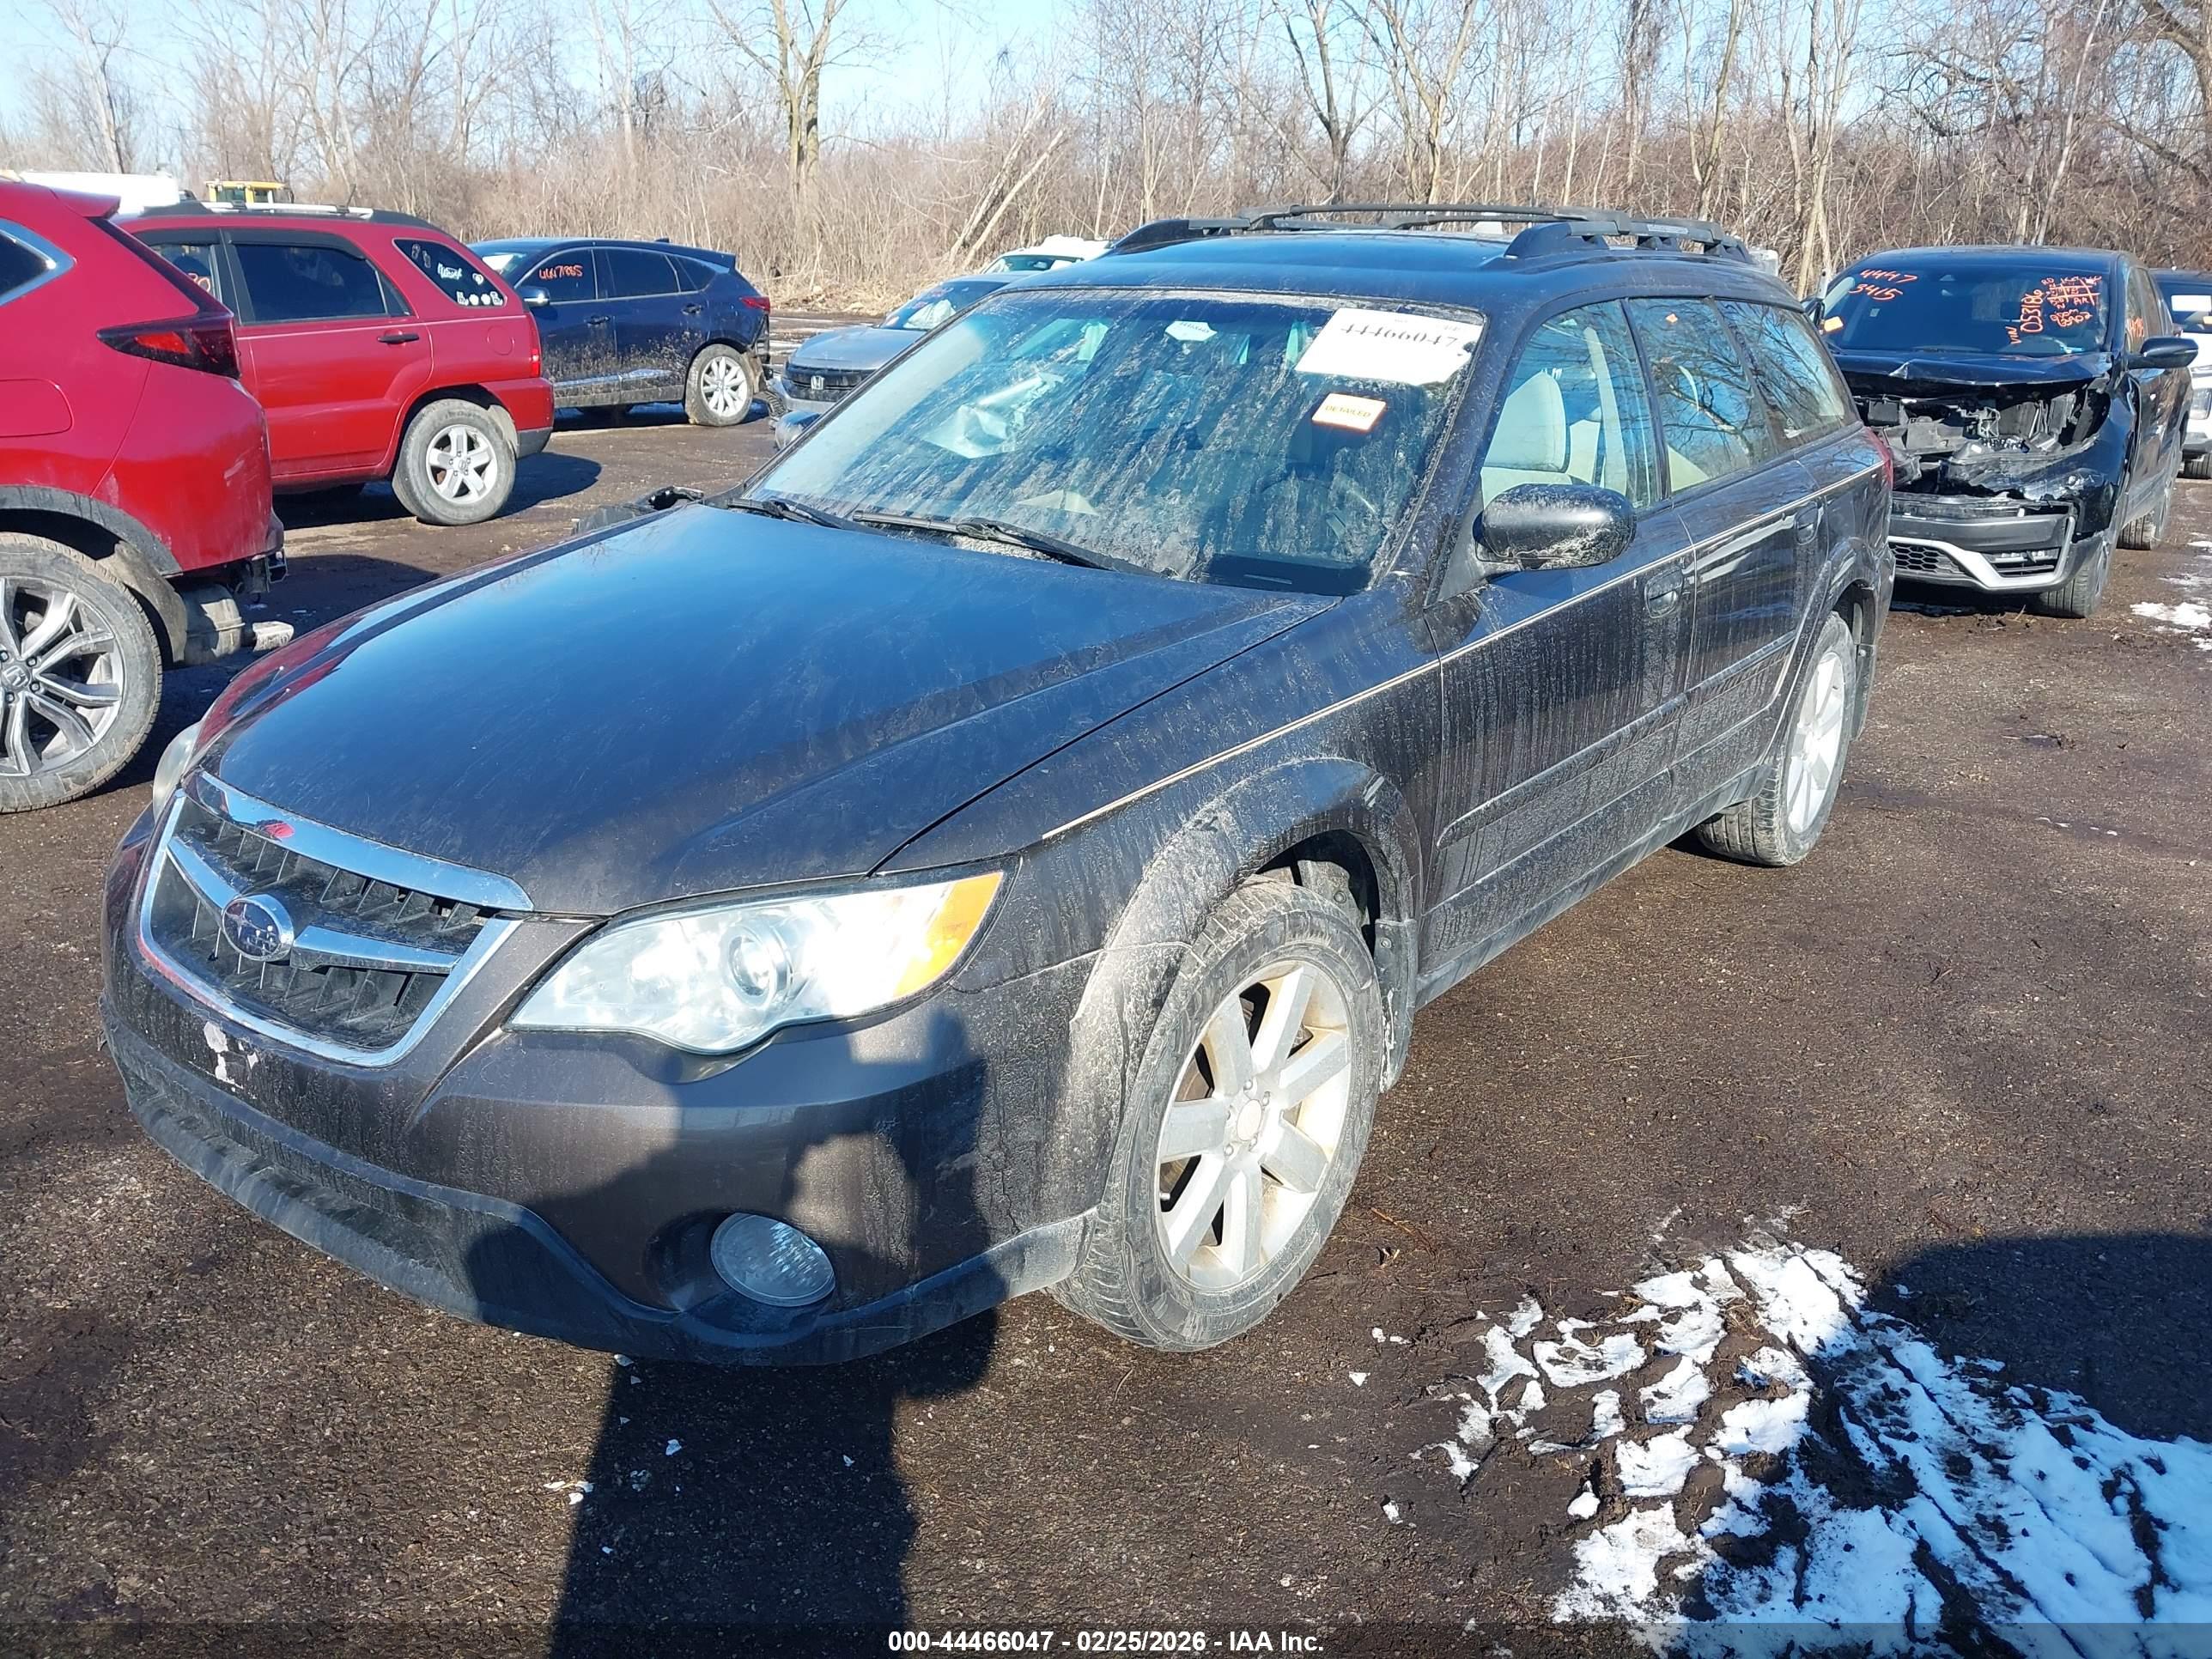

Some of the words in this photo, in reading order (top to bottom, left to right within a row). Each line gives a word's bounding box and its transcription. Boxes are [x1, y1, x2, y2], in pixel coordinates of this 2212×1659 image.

[1860, 269, 1918, 283] 4447
[1848, 283, 1904, 301] 3415
[2020, 289, 2045, 333] 053186
[1340, 323, 1459, 348] 44466047
[2004, 325, 2022, 345] VIN
[1324, 404, 1372, 419] DETAILED
